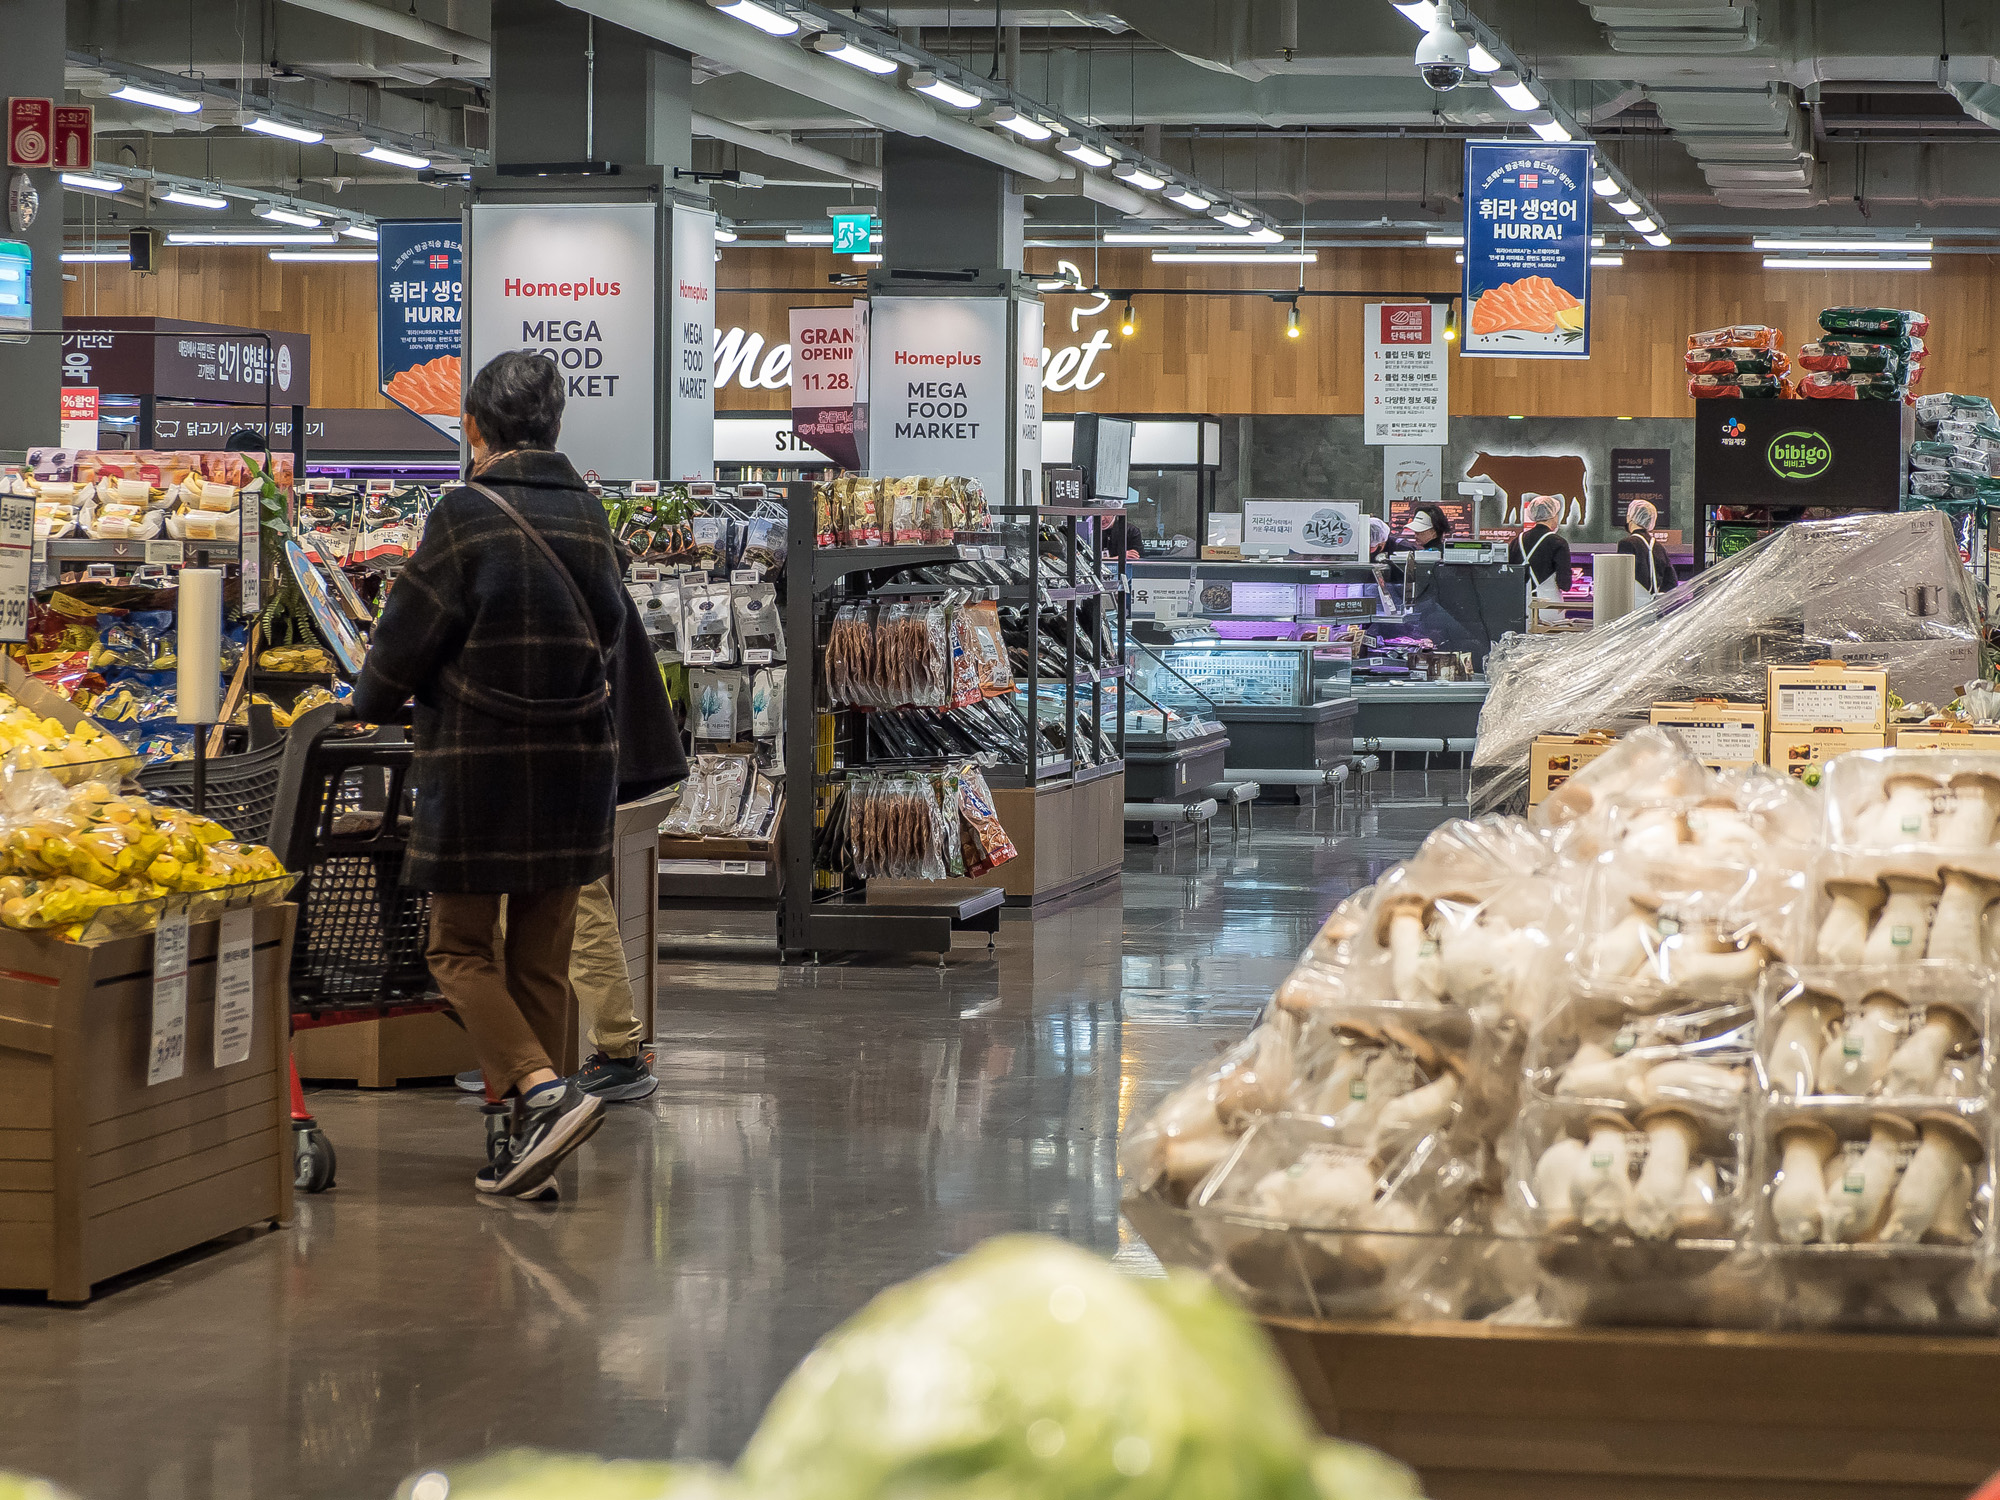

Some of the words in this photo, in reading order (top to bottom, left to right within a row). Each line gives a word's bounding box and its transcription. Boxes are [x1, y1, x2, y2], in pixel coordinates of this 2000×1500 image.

[58, 112, 88, 124] 소화기
[1478, 198, 1518, 220] 휘라
[1520, 198, 1577, 221] 생연어
[1494, 223, 1562, 240] HURRA!
[389, 280, 428, 303] 휘라
[504, 277, 621, 301] Homeplus
[679, 279, 708, 304] Homeplus
[62, 330, 114, 348] 기반찬
[522, 320, 602, 342] MEGA
[683, 322, 704, 346] MEGA
[218, 342, 240, 382] 인기
[522, 348, 603, 370] OOD
[683, 350, 704, 372] FOOD
[714, 327, 792, 390] Me
[894, 350, 982, 368] Homeplus
[1374, 351, 1381, 359] 1.
[1401, 351, 1415, 359] 단독
[1417, 351, 1431, 359] 할인
[679, 377, 707, 400] MARKET
[908, 382, 968, 398] MEGA
[1024, 384, 1036, 400] MEGA
[908, 402, 968, 418] FOOD
[1024, 404, 1036, 420] FOOD
[895, 422, 980, 438] MARKET
[1022, 424, 1038, 440] MARKET
[1722, 425, 1732, 433] CJ
[1774, 444, 1827, 464] bibigo
[1055, 480, 1065, 499] 진도
[1066, 480, 1080, 499] 특산물
[1305, 519, 1348, 537] 지리산
[1142, 540, 1158, 548] 도별
[1159, 540, 1173, 548] 부위
[1174, 540, 1188, 548] 제안
